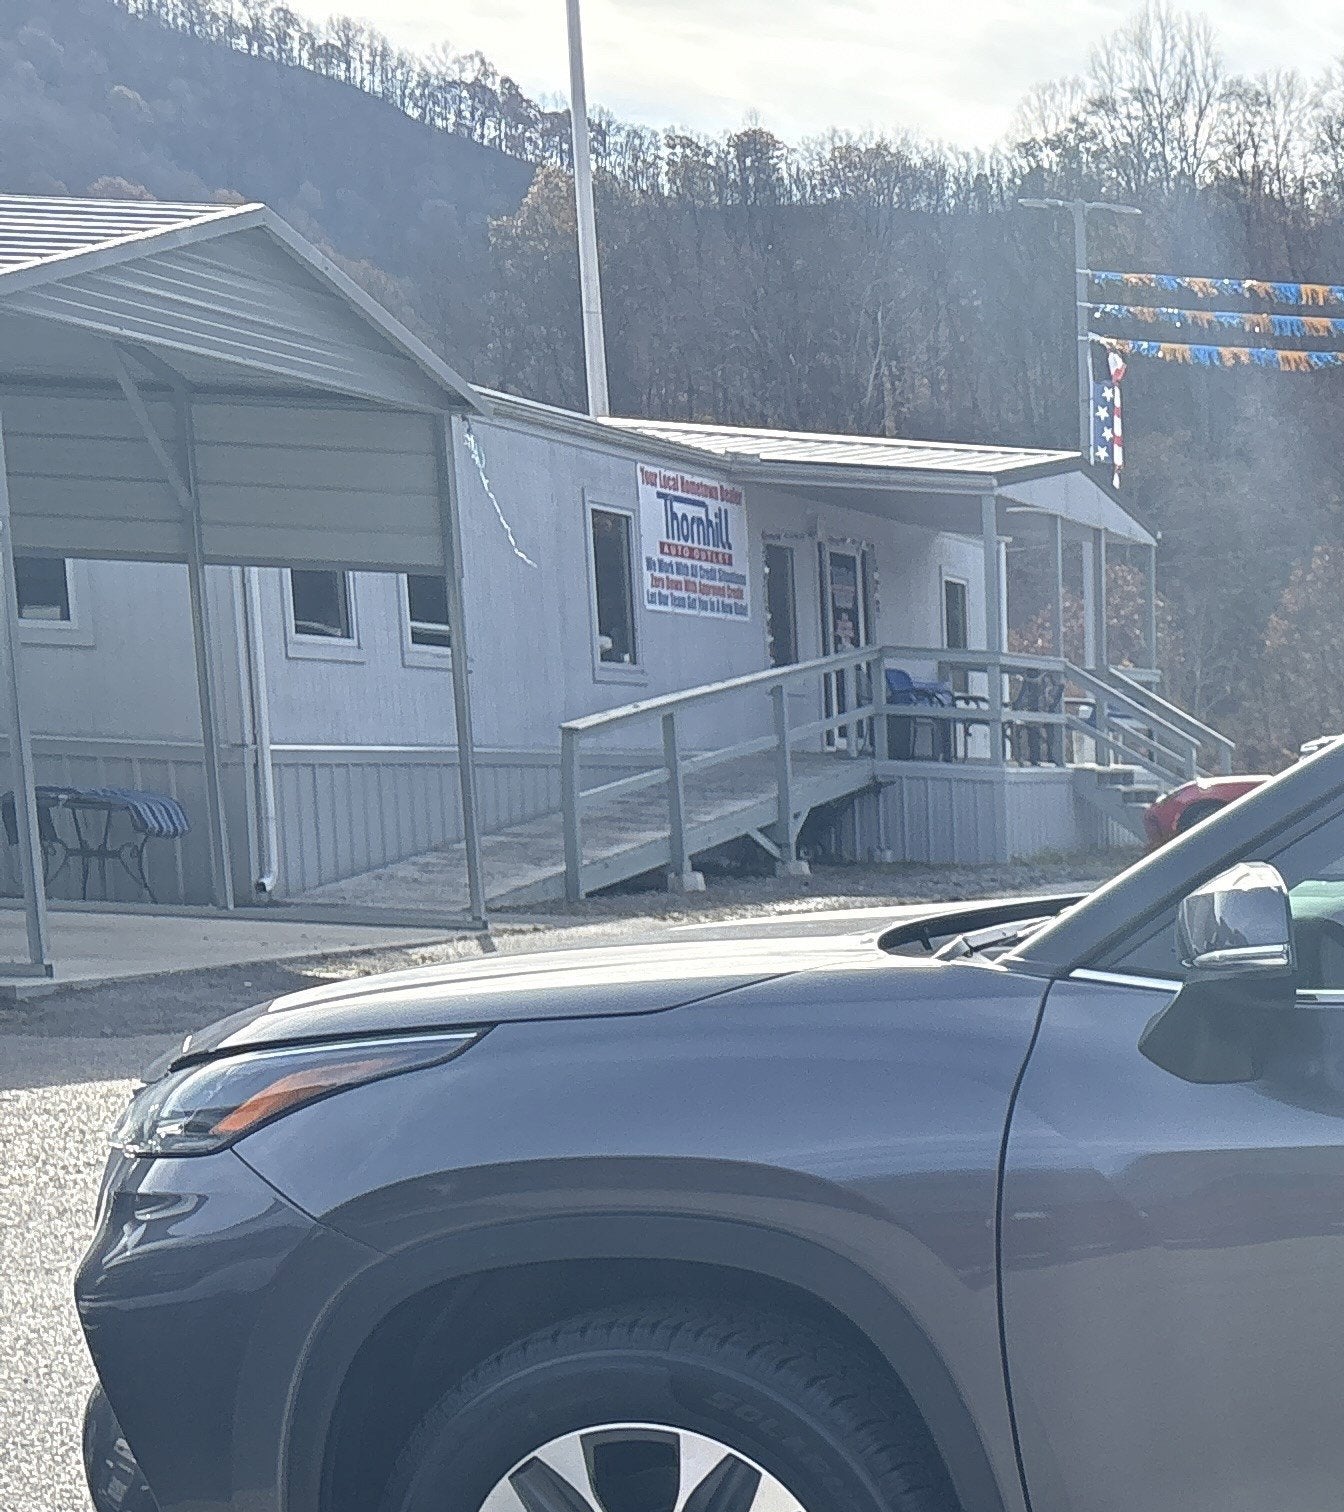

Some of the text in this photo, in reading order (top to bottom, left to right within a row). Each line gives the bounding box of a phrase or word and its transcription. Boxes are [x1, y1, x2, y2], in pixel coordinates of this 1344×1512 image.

[659, 470, 679, 492] Local
[656, 490, 732, 550] Thornhill
[663, 544, 730, 564] AUTO OUTLET
